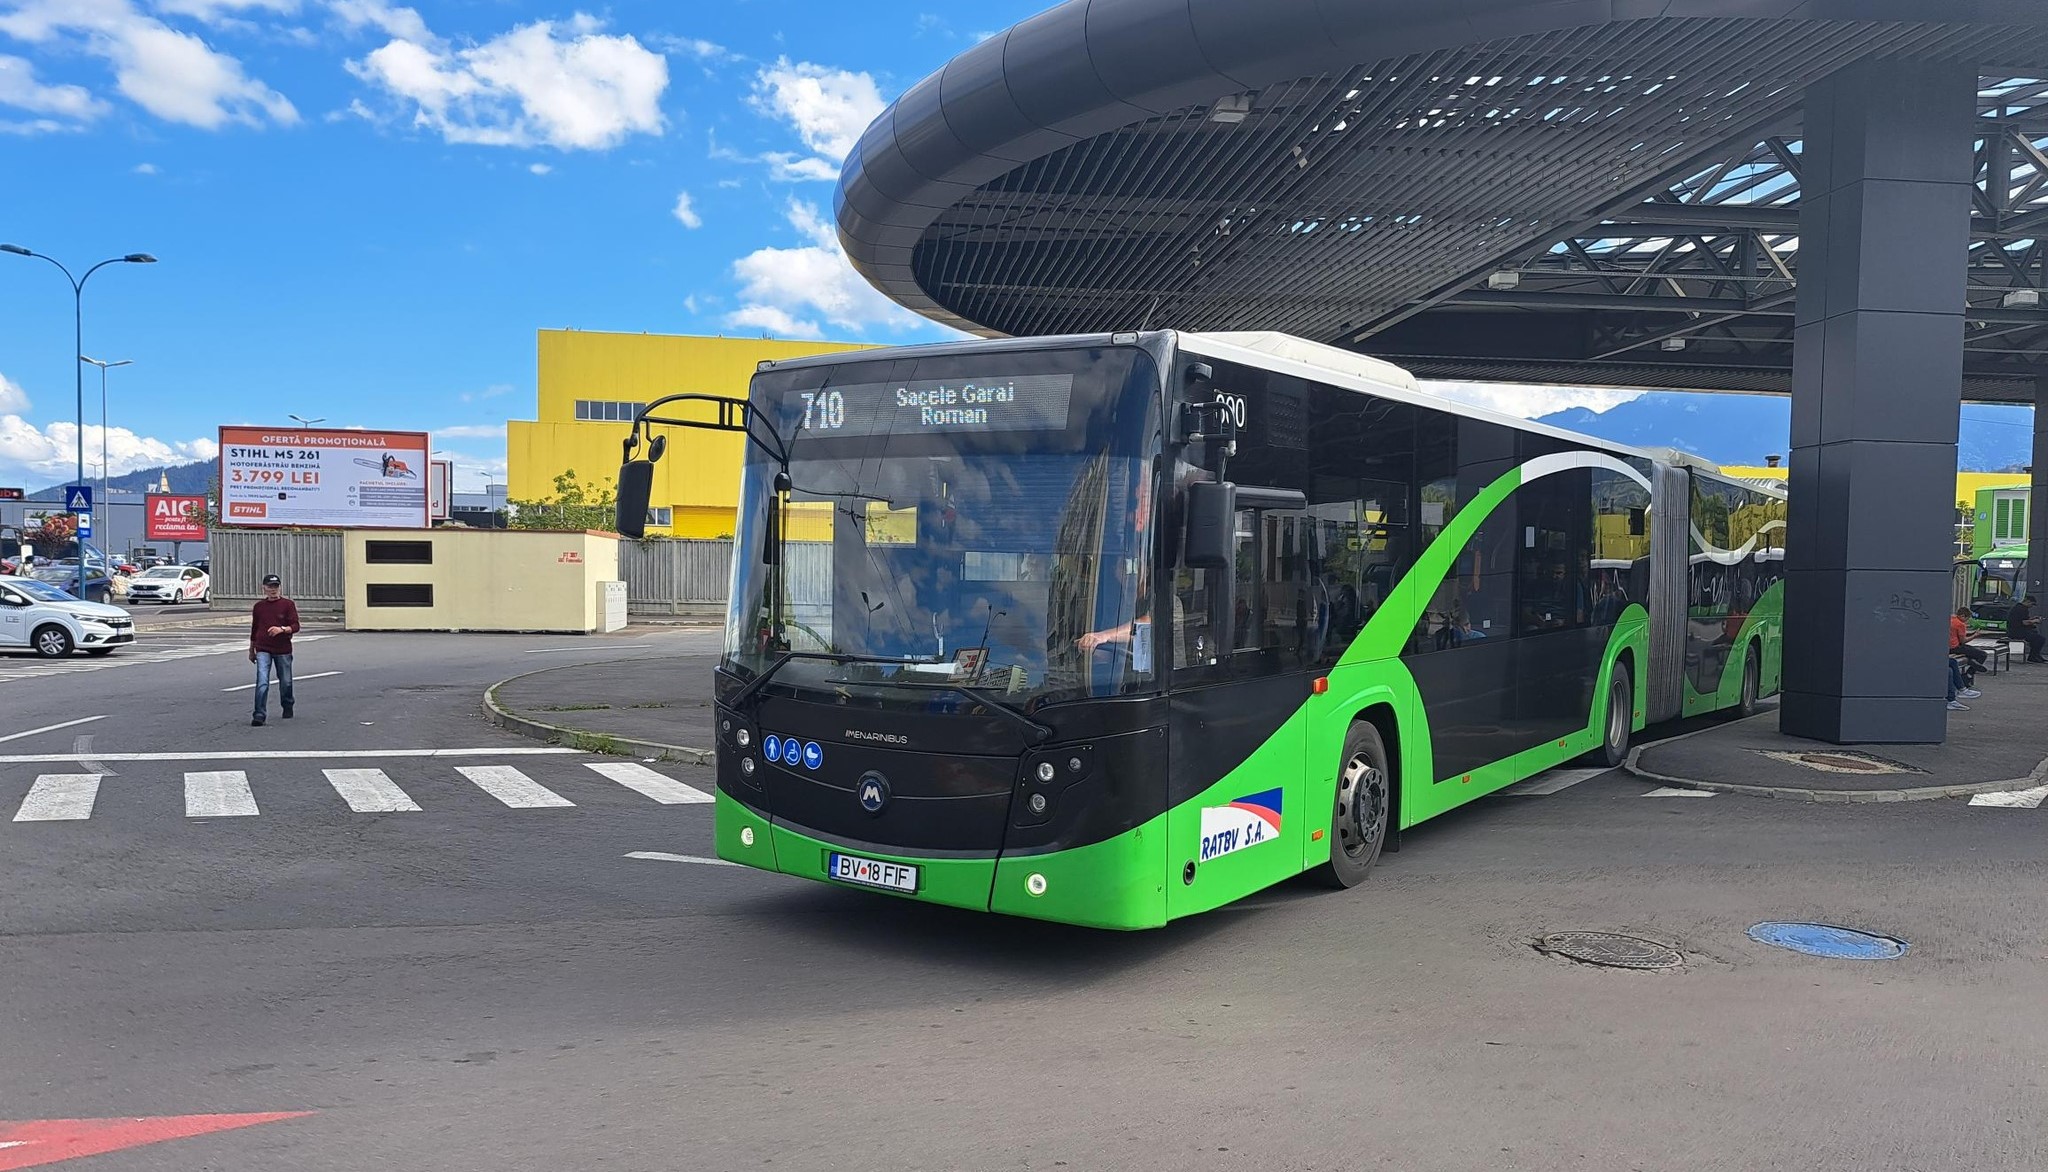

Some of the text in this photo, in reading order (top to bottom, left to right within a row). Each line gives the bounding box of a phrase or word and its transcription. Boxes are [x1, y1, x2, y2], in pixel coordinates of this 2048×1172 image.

[896, 386, 957, 406] Sacele
[800, 391, 844, 429] 710
[921, 406, 987, 425] Roman
[262, 435, 301, 444] OFERTĂ
[231, 448, 320, 460] STIHL MS 261
[232, 469, 319, 484] 3.799 LEI
[233, 506, 262, 514] STIHL
[155, 522, 185, 530] reclama
[1201, 820, 1264, 860] RATBV S.A.
[840, 857, 861, 878] BV
[867, 862, 881, 881] 18
[884, 865, 910, 886] FIF
